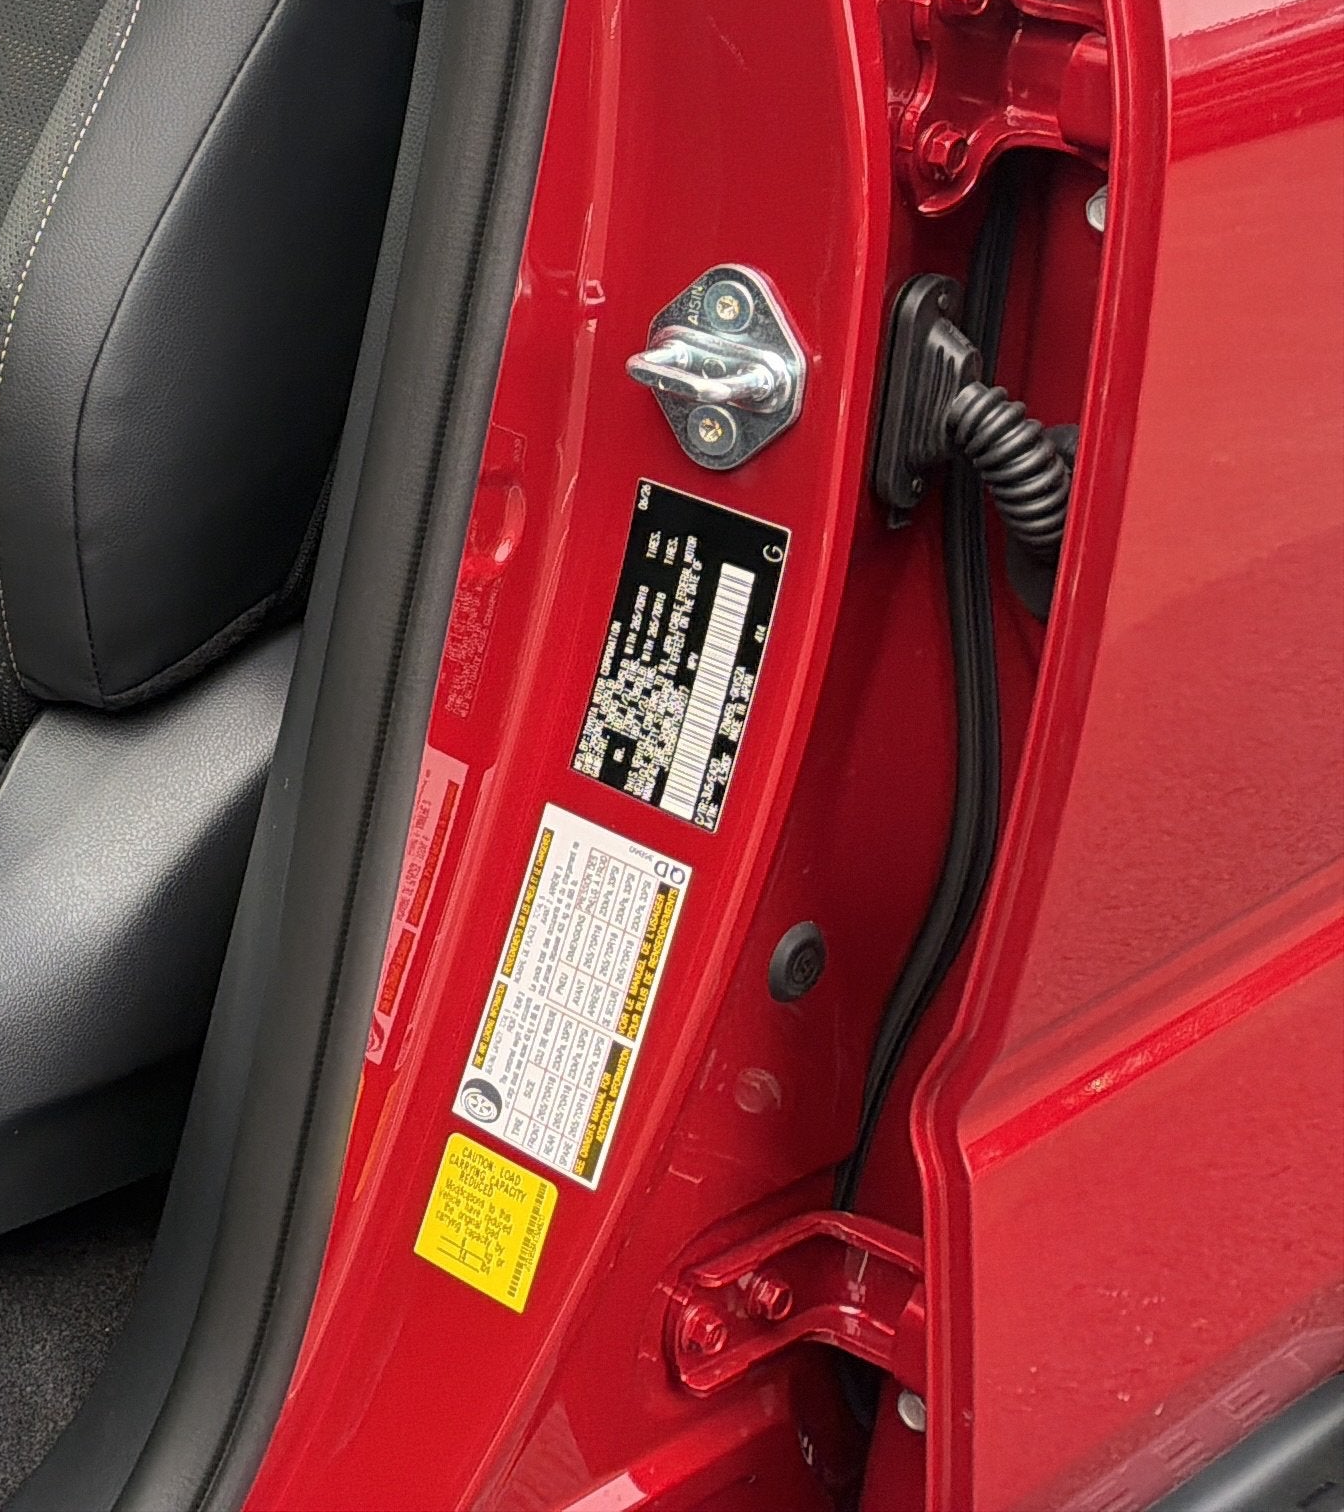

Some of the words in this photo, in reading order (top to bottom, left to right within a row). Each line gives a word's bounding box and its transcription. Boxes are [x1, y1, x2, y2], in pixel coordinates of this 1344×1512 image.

[687, 285, 705, 325] AISIN
[645, 527, 662, 560] TIRES.
[662, 534, 680, 566] TIRES.
[682, 534, 698, 563] MOTOR
[761, 542, 784, 564] G
[691, 557, 703, 571] OF
[592, 676, 605, 704] MOTOR
[599, 619, 621, 676] CORPORATION
[637, 482, 652, 511] 06/26
[675, 564, 693, 601] FEDERAL
[686, 571, 700, 595] DATE
[629, 584, 649, 632] 265/70R18
[646, 590, 666, 638] 265/70R18
[681, 596, 694, 613] THE
[662, 602, 683, 655] APPLICABLE
[678, 614, 689, 629] ON
[623, 630, 637, 655] WITH
[640, 637, 654, 662] WITH
[670, 630, 686, 663] EFFECT
[657, 654, 669, 673] ALL
[666, 662, 678, 676] IN
[654, 673, 664, 687] TO
[739, 672, 754, 701] JAPAN
[735, 702, 746, 715] IN
[643, 726, 660, 759] SAFETY
[728, 717, 742, 742] MADE
[630, 731, 647, 770] VEHICLE
[623, 769, 636, 793] THIS
[632, 759, 649, 797] VEHICLE
[576, 871, 593, 909] PRESSION
[587, 854, 598, 871] DES
[585, 887, 598, 914] PNEUS
[595, 854, 607, 878] FROID
[652, 857, 687, 886] QD
[645, 892, 666, 939] L'USAGER
[647, 887, 679, 969] RENSEIGNEMENTS
[555, 971, 568, 995] PNEU
[565, 913, 586, 962] DIMENSIONS
[598, 931, 619, 977] 265/70R18
[613, 938, 634, 985] 265/70R18
[640, 940, 651, 955] DE
[571, 978, 585, 1006] AVANT
[582, 923, 603, 970] 265/70R18
[628, 956, 646, 996] MANUEL
[643, 970, 654, 985] DE
[624, 996, 634, 1010] LE
[635, 986, 649, 1012] PLUS
[616, 1011, 630, 1035] VOIR
[626, 1013, 641, 1040] POUR
[523, 1078, 535, 1099] SIZE
[536, 1075, 556, 1121] 265/70R18
[595, 1098, 615, 1143] ADDITIONAL
[608, 1046, 630, 1098] INFORMATION
[543, 1133, 555, 1156] REAR
[551, 1083, 572, 1130] 265/70R18
[558, 1140, 572, 1166] SPARE
[567, 1091, 588, 1138] 265/70R18
[574, 1157, 585, 1175] SEE
[590, 1089, 606, 1122] MANUAL
[600, 1071, 611, 1090] FOR
[448, 1152, 487, 1182] CARRYING
[488, 1174, 527, 1204] CAPACITY
[458, 1170, 494, 1198] REDUCED
[499, 1166, 522, 1187] LOAD
